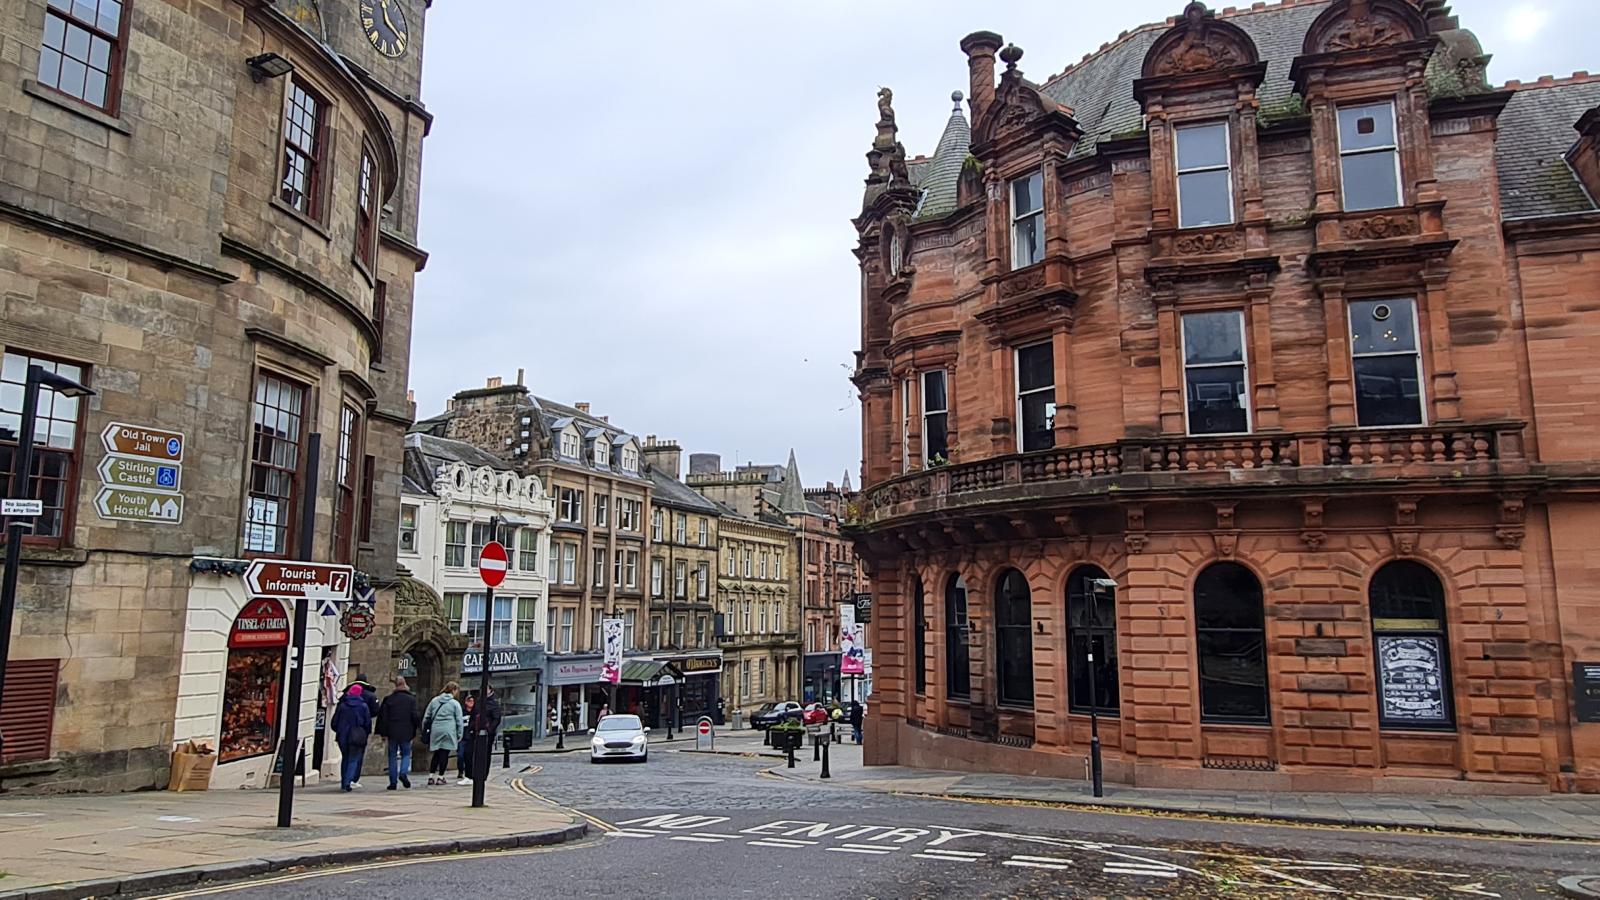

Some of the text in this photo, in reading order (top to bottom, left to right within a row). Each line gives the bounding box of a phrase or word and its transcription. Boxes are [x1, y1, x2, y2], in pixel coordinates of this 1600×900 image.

[121, 429, 165, 444] Old Town
[134, 441, 151, 452] Jail
[118, 460, 156, 476] Stirling
[118, 472, 153, 485] Castle
[118, 492, 147, 505] Youth
[113, 504, 147, 517] Hostel
[280, 567, 317, 580] Tourist
[463, 651, 520, 667] CAF AINA
[615, 813, 980, 846] NO ENTRY
